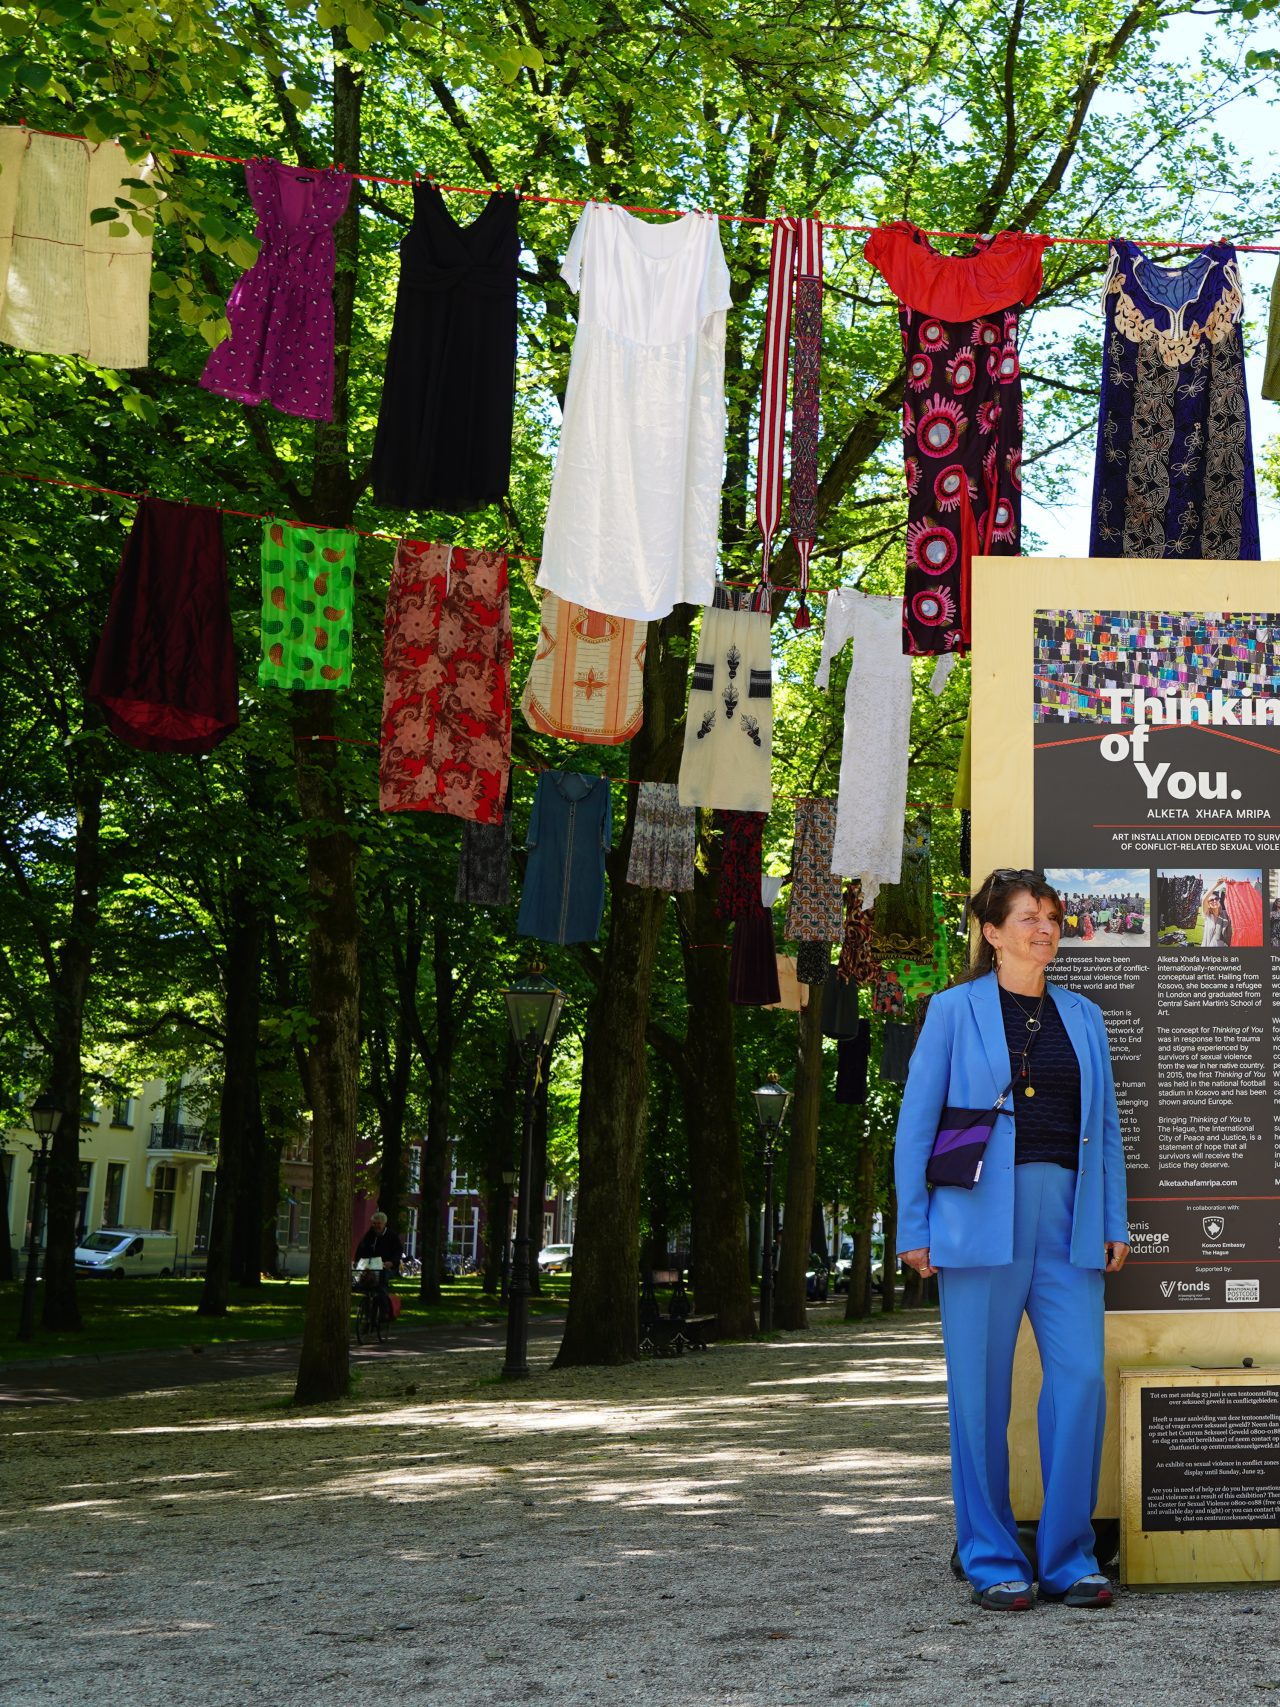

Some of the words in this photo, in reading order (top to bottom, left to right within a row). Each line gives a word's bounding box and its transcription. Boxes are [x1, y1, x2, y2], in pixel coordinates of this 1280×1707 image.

[1100, 725, 1150, 762] of
[1134, 762, 1242, 800] You.
[1147, 809, 1189, 818] ALKETA
[1196, 809, 1232, 818] XHAFA
[1236, 809, 1270, 818] MRIPA
[1218, 973, 1241, 981] Hailing
[1236, 982, 1262, 990] refugee
[1208, 991, 1242, 999] graduated
[1158, 1179, 1237, 1187] Alketaxhafamripa.com
[1128, 1231, 1169, 1245] kwege
